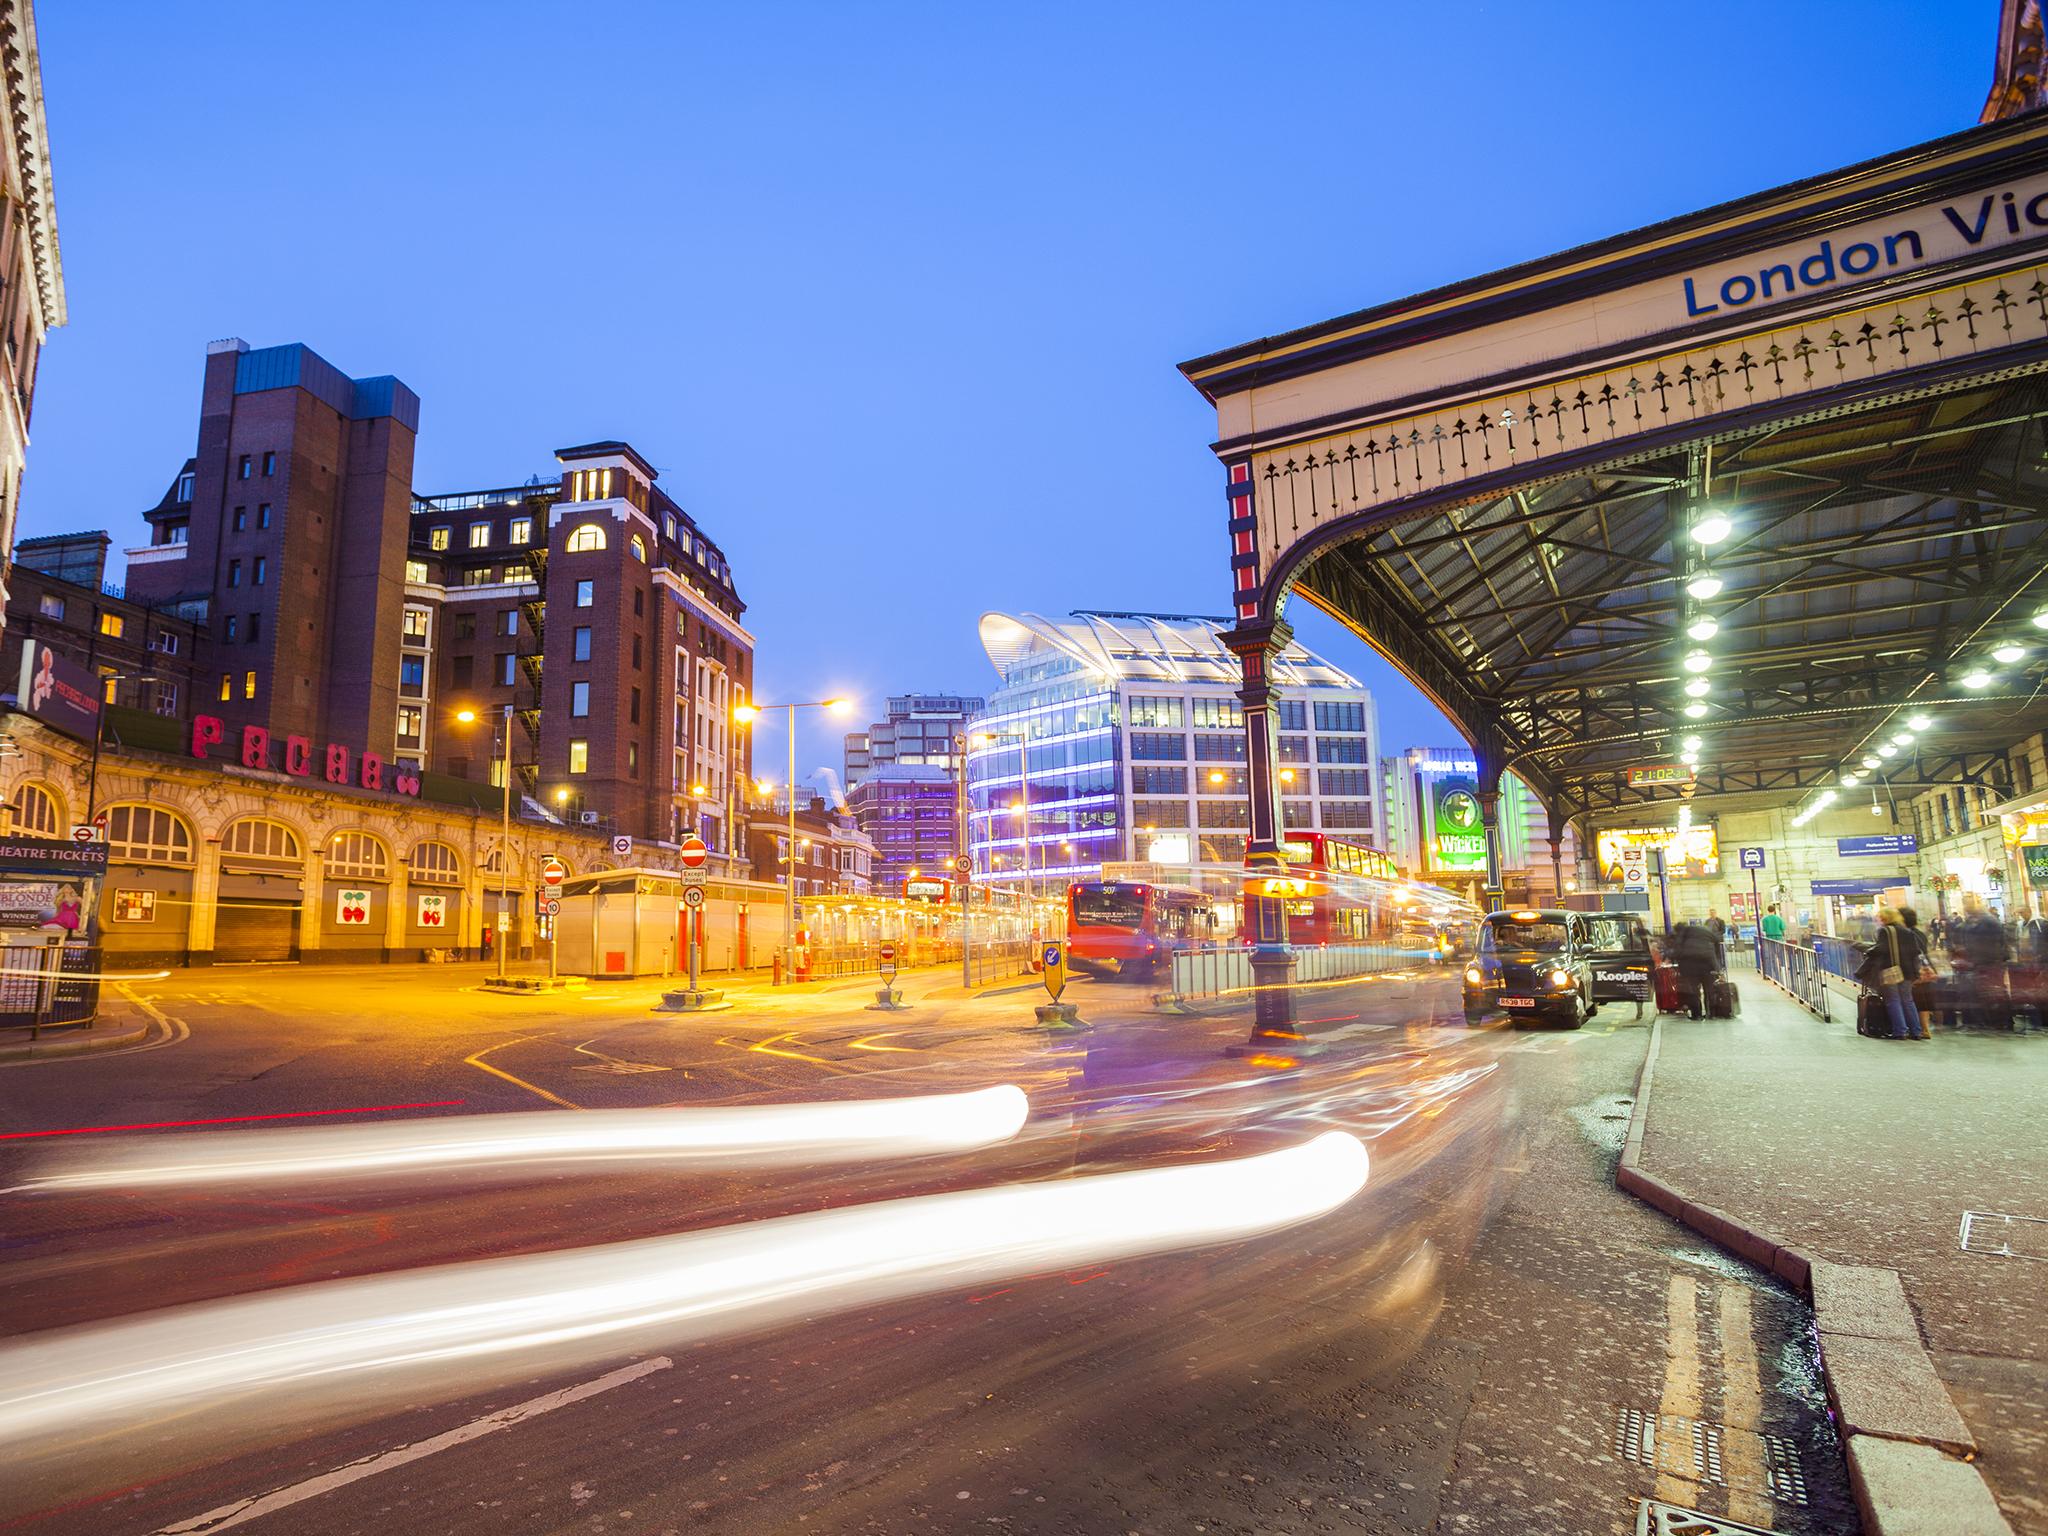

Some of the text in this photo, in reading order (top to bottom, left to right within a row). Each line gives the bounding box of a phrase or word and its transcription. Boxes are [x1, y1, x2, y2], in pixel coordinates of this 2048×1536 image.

[1683, 191, 2048, 317] London Vic
[192, 714, 382, 790] PACHA
[51, 849, 105, 862] TICKETS
[959, 860, 968, 868] 10
[1103, 886, 1116, 895] 507
[1, 893, 53, 902] BLONDE
[688, 892, 700, 902] 10
[548, 903, 558, 912] 10
[1596, 970, 1648, 983] Kooples
